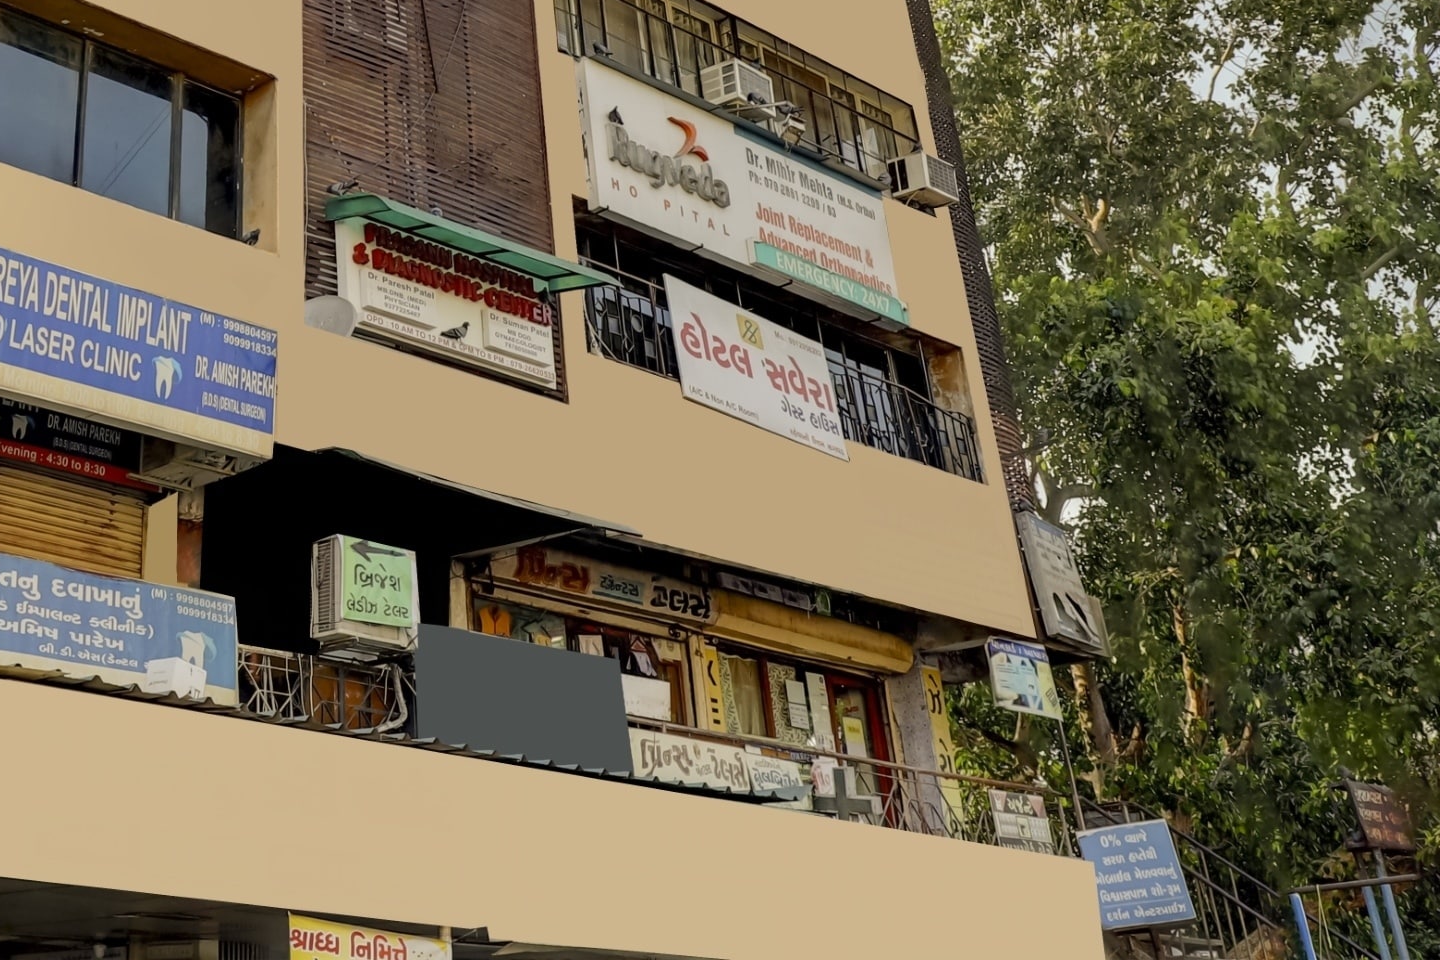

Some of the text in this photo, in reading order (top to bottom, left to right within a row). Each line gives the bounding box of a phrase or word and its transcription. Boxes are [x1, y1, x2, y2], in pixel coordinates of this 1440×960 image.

[746, 148, 763, 169] Dr.
[766, 156, 796, 184] Mihir
[799, 172, 834, 201] Mehta
[756, 203, 874, 268] Joint Replacement &
[352, 242, 553, 327] & DIAGNOSTIC CENTER
[382, 276, 412, 292] Paresh
[414, 286, 434, 299] Patel
[42, 270, 112, 334] DENTAL
[116, 292, 192, 355] IMPLANT
[367, 313, 384, 325] OPD
[402, 324, 414, 335] AM
[416, 329, 426, 339] TO
[502, 317, 529, 331] Suman
[531, 326, 550, 338] Patel
[8, 318, 74, 365] LASER
[80, 339, 143, 382] CLINIC
[679, 312, 754, 380] હોટલ
[195, 355, 275, 399] DR. AMISH PAREKH
[47, 414, 122, 446] DR. AMISH PAREKH
[810, 413, 840, 436] હાઉસ
[46, 453, 69, 469] 4:30
[70, 457, 82, 471] to
[83, 461, 106, 477] 8:30
[353, 563, 401, 594] બ્રિજેશ
[51, 577, 143, 619] દવાખાનું
[384, 598, 409, 620] ટેલર
[69, 627, 124, 652] પારેખ
[1100, 833, 1121, 848] 0%
[1102, 854, 1125, 866] સરળ
